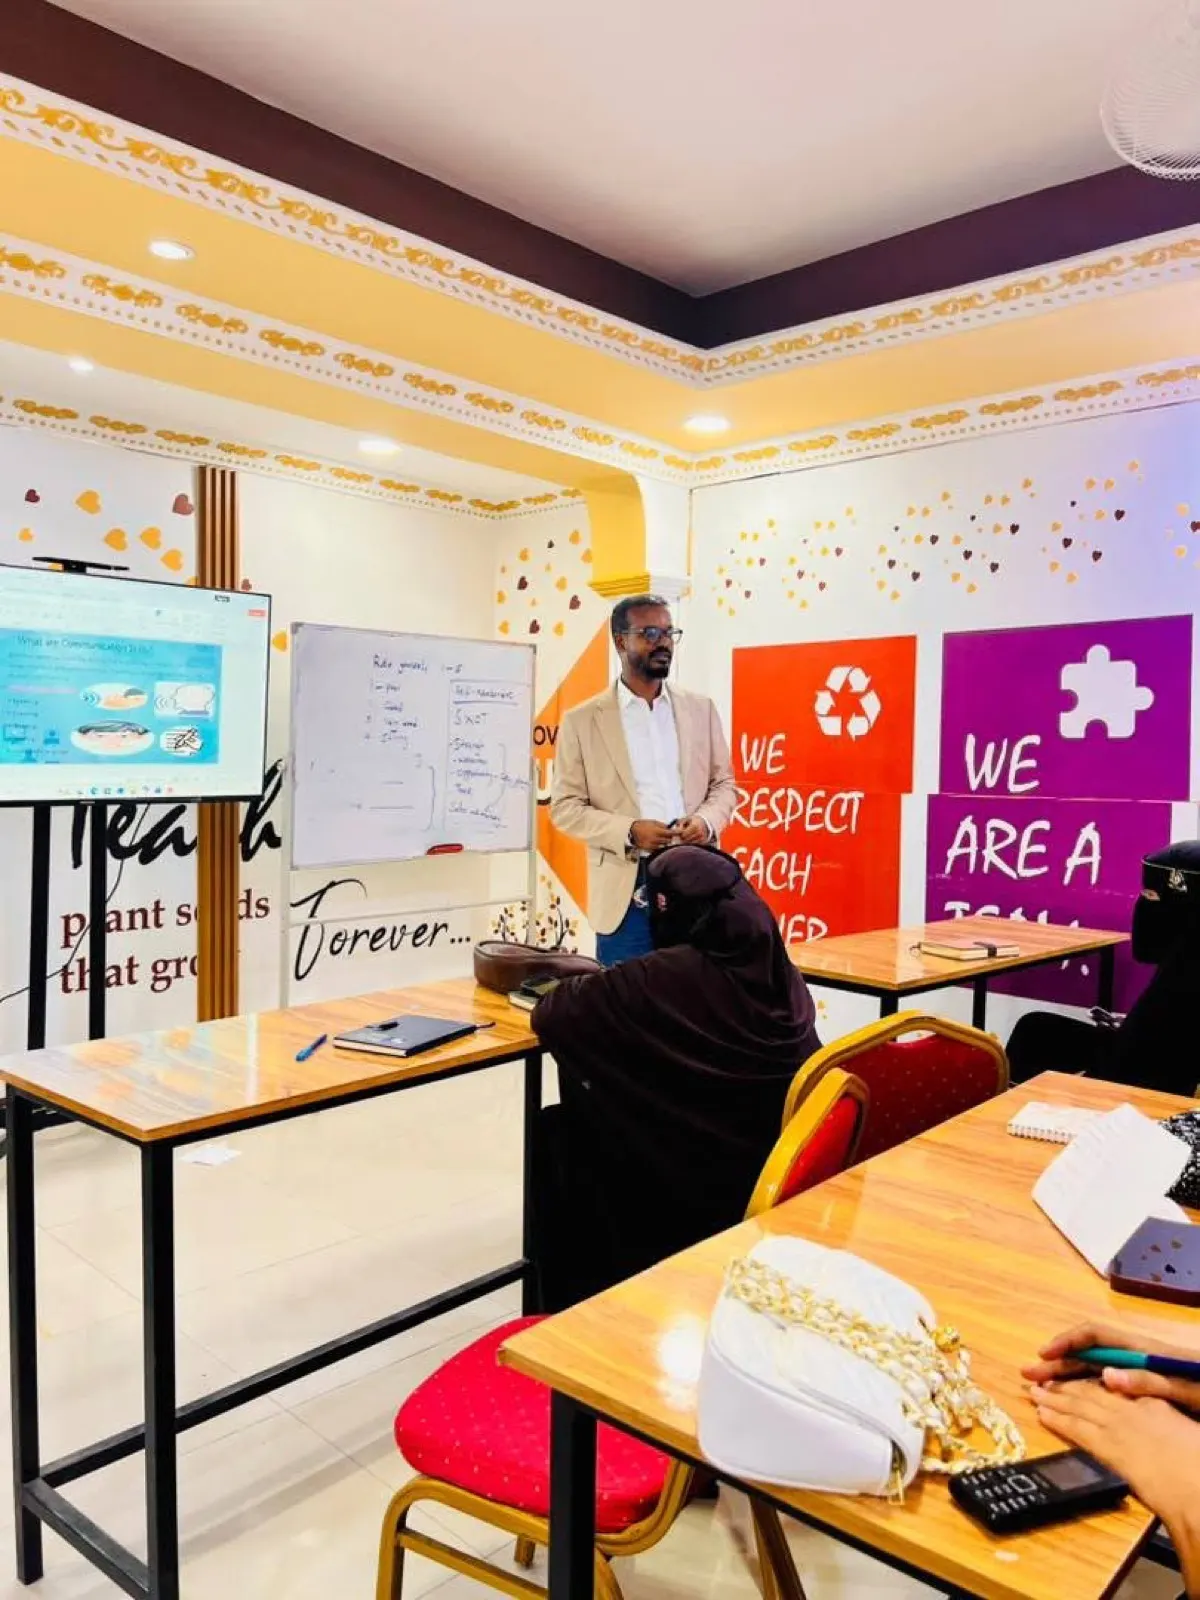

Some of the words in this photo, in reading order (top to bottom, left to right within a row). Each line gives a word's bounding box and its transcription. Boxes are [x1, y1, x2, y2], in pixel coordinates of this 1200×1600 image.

[740, 732, 786, 774] WE
[965, 733, 1041, 793] WE
[945, 815, 1051, 880] ARE
[1063, 821, 1102, 886] A
[60, 899, 165, 949] pant
